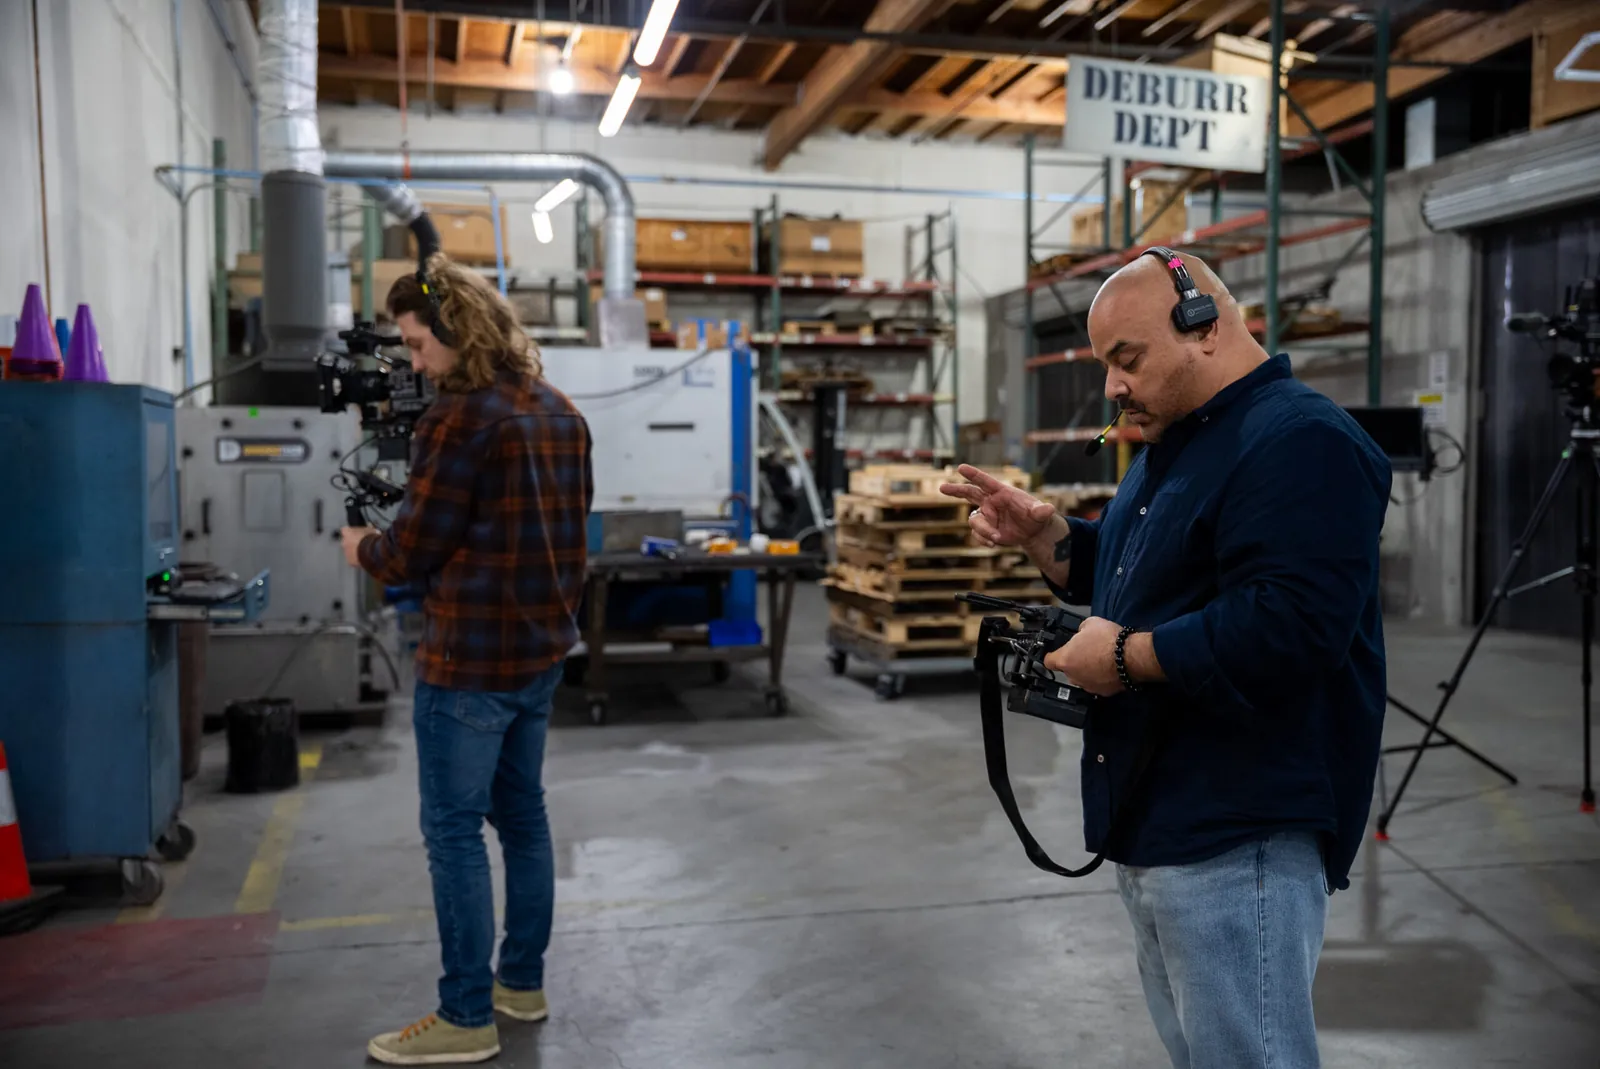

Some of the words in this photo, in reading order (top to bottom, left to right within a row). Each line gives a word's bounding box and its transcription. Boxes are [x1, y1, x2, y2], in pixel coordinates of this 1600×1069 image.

[1083, 65, 1249, 114] DEBURR
[1113, 110, 1216, 152] DEPT
[1187, 289, 1198, 299] M
